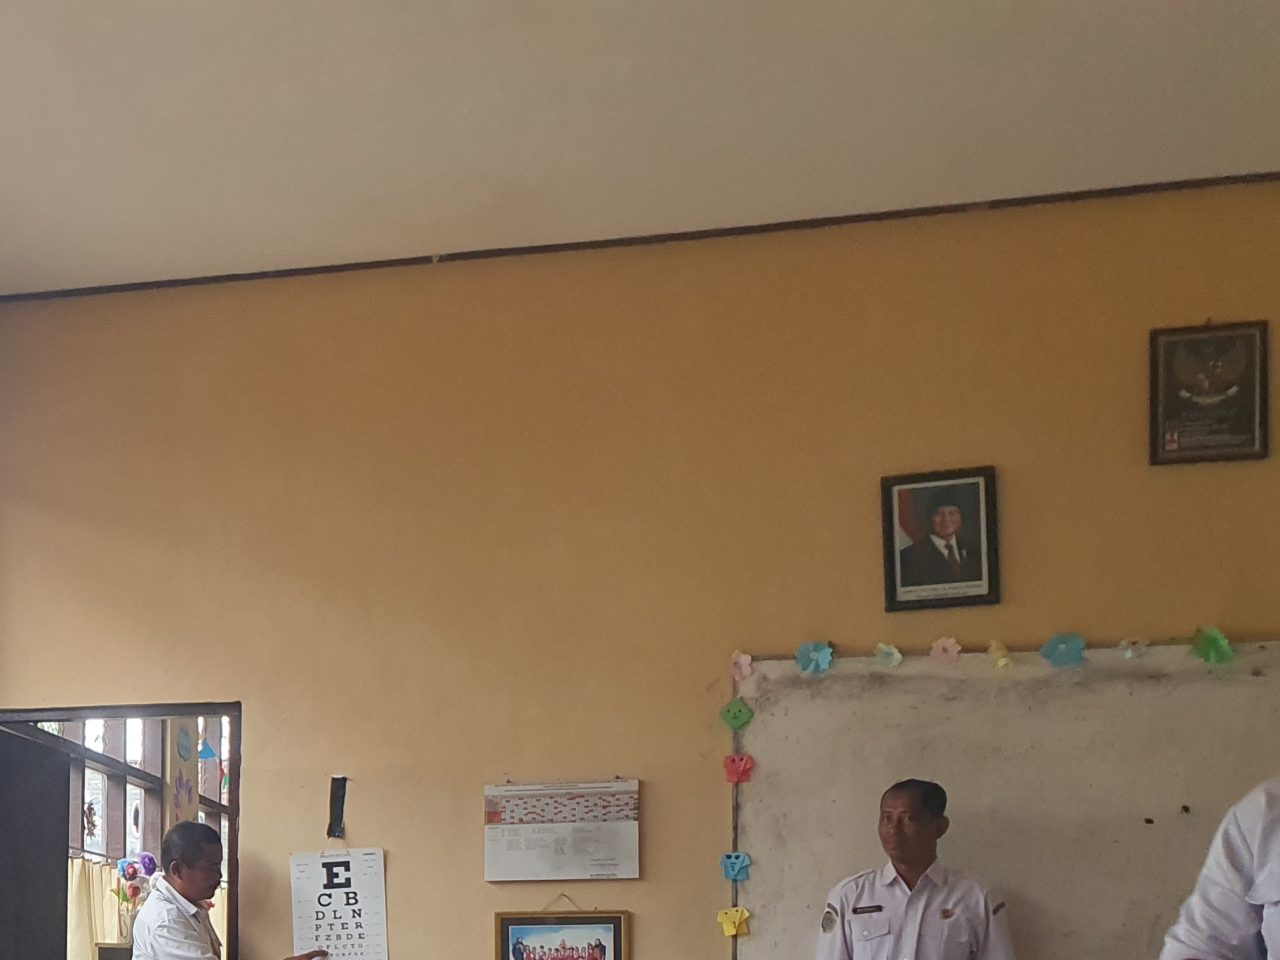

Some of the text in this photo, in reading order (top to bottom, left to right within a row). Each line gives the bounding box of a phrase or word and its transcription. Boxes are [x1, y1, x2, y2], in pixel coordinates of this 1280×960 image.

[322, 861, 351, 889] E
[317, 891, 359, 907] C B
[315, 908, 362, 920] D L N
[340, 922, 349, 930] E
[354, 921, 363, 929] R
